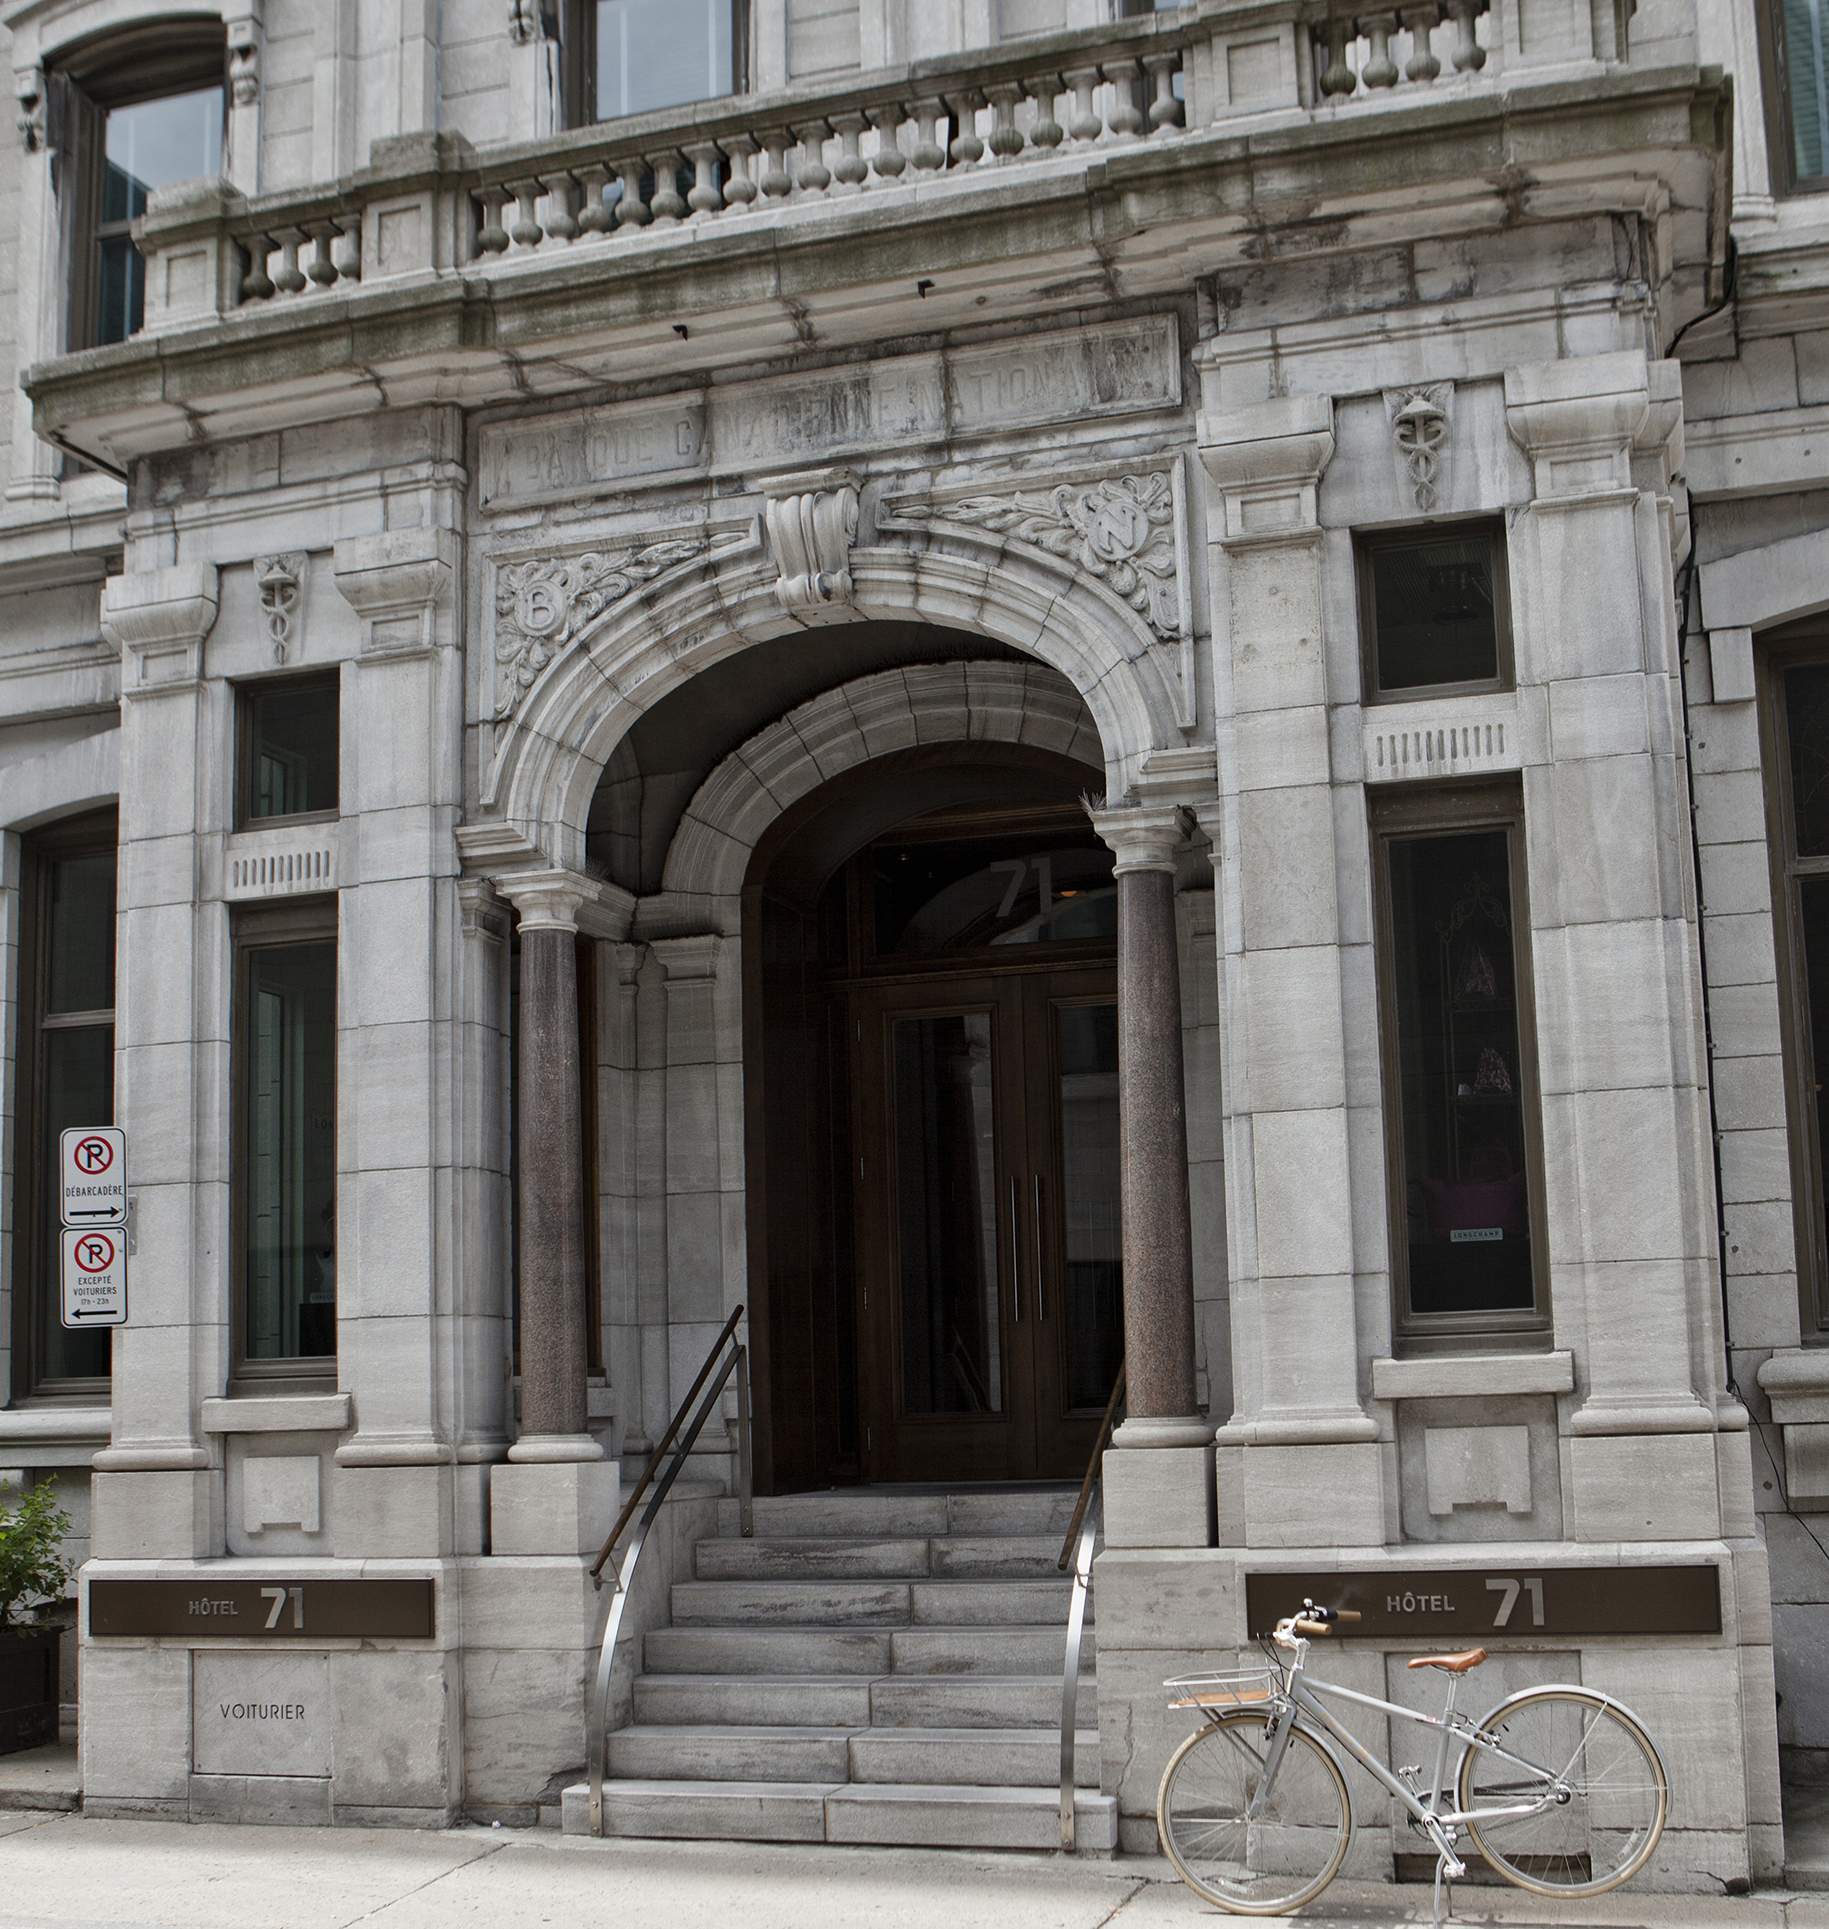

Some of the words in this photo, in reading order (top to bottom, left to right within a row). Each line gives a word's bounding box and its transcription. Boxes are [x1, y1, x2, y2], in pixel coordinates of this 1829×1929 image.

[989, 856, 1053, 918] 71
[65, 1183, 123, 1197] DÉBARCADÈRE
[1454, 1230, 1499, 1239] LONGCHAMP
[78, 1274, 112, 1286] EXCEPTÉ
[73, 1286, 118, 1297] VOITURIERS
[188, 1597, 239, 1616] HÔTEL
[260, 1586, 304, 1629] 71
[1386, 1591, 1456, 1613] HÔTEL
[1484, 1577, 1546, 1627] 71
[220, 1703, 306, 1720] VOITURIER
